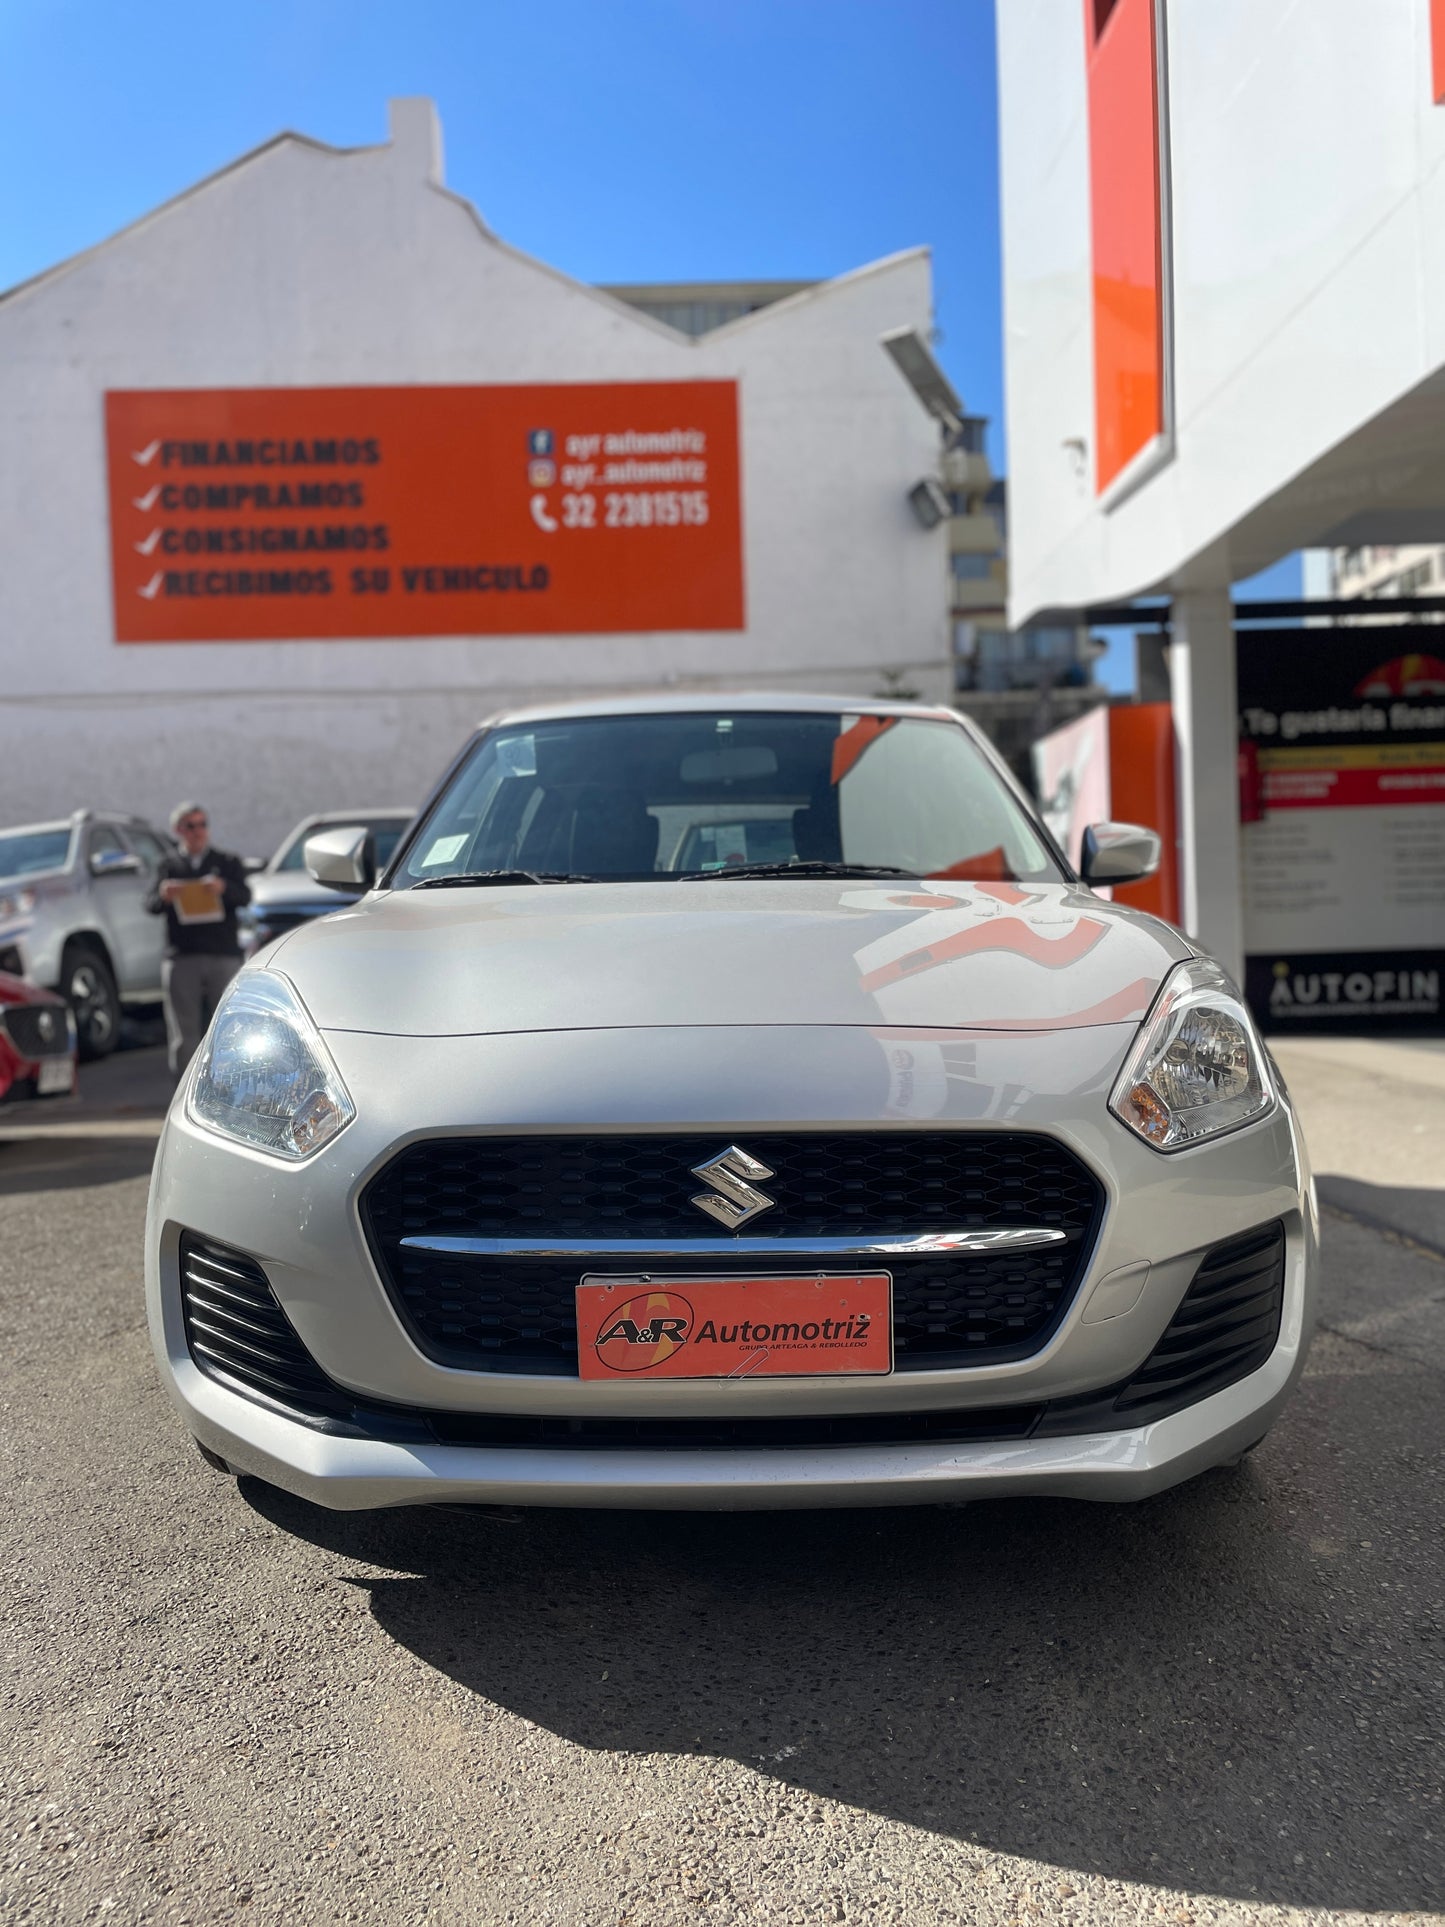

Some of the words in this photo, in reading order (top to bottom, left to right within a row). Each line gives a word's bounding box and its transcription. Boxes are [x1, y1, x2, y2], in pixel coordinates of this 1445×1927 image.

[161, 437, 381, 467] FINANCIAMOS
[566, 434, 600, 461] ayr
[604, 428, 707, 455] automotriz
[561, 458, 707, 491] ayr_automotriz
[161, 482, 364, 510] COMPRAMOS
[562, 492, 597, 528] 32
[604, 490, 709, 528] 2381515
[162, 525, 389, 556] CONSIGNAMOS
[165, 567, 332, 598] RECIBIMOS
[352, 566, 390, 595] SU
[402, 563, 549, 594] VEHICULO
[1270, 963, 1440, 1004] AUTOFIN
[594, 1318, 688, 1345] A&R
[694, 1314, 871, 1344] Automotriz
[770, 1342, 808, 1350] ARTEAGA
[819, 1341, 868, 1349] REBOLLEDO
